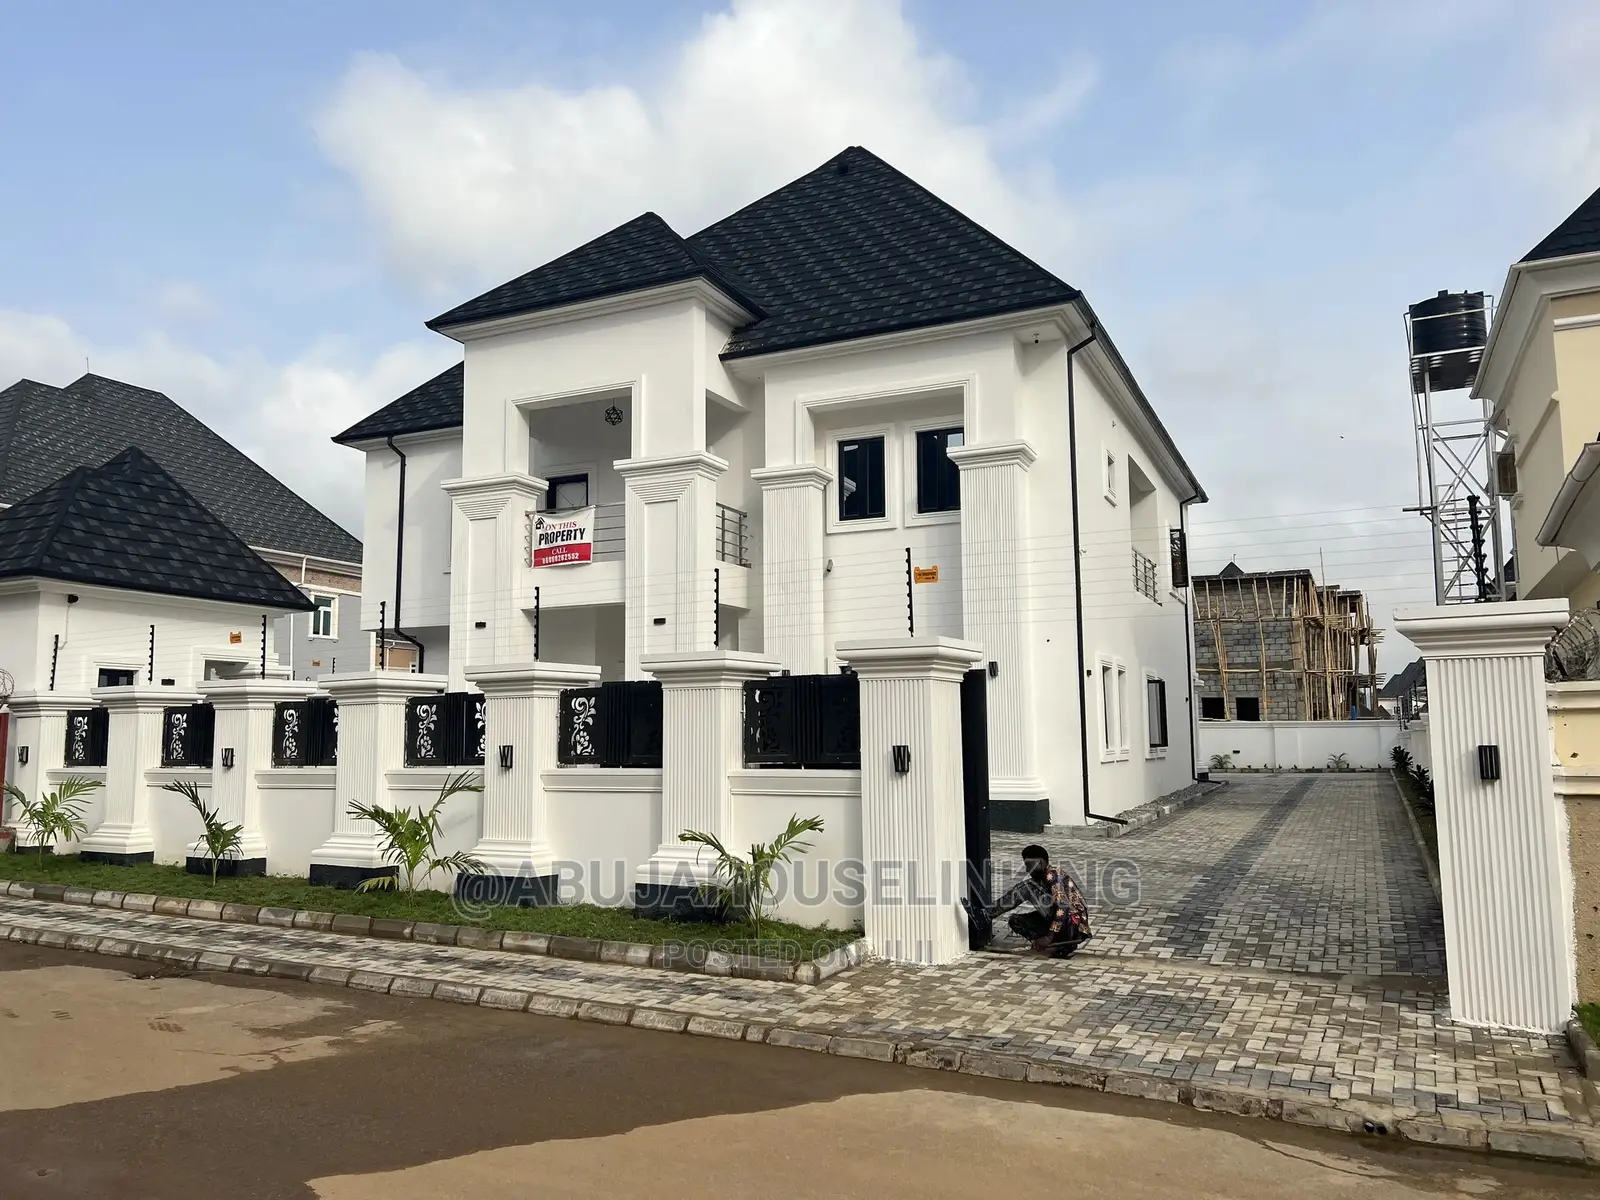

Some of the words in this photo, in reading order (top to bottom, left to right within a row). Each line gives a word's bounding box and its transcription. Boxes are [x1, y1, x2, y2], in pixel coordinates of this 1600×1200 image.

[558, 521, 577, 530] THIS
[539, 528, 586, 545] PROPERTY
[552, 547, 568, 555] CALL
